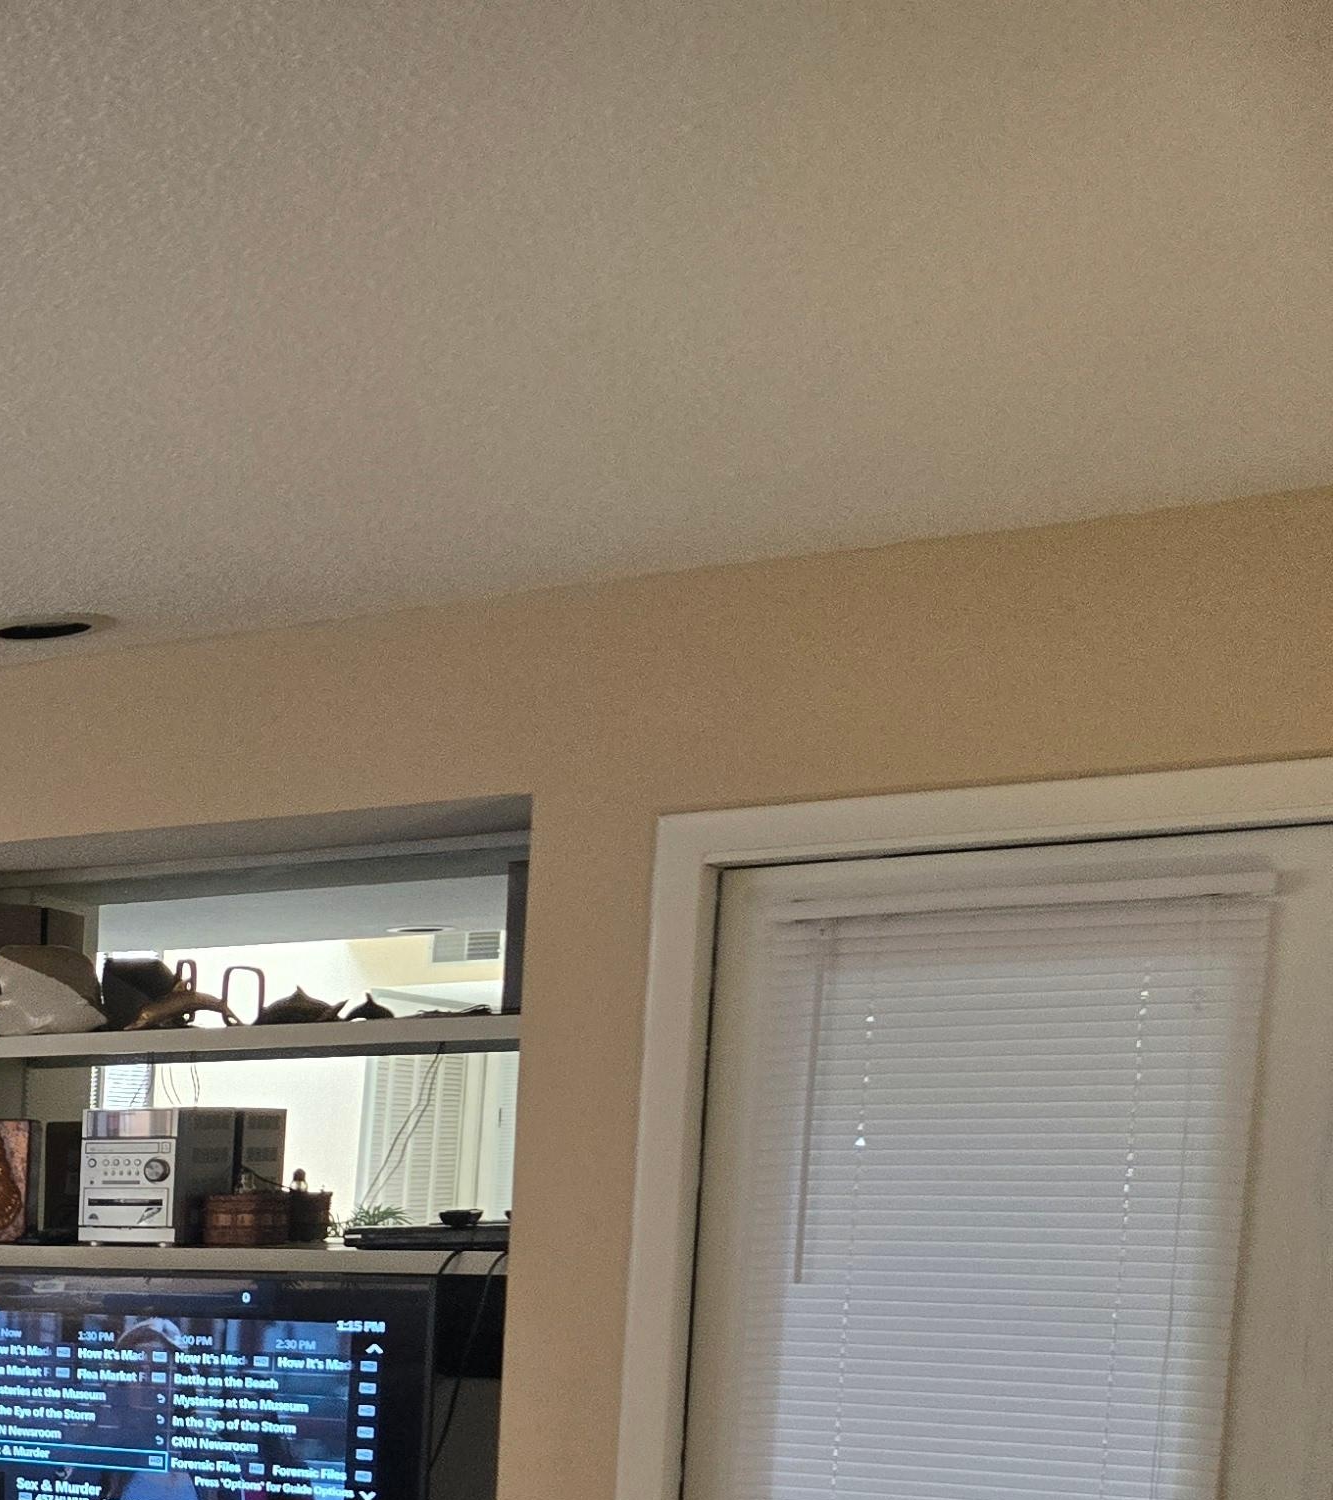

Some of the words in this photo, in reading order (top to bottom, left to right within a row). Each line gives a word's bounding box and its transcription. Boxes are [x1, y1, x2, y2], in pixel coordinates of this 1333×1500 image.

[1, 1328, 22, 1338] Now
[364, 1321, 385, 1333] PM
[78, 1331, 97, 1341] 1:30
[99, 1332, 114, 1342] PM
[196, 1336, 213, 1346] PM
[10, 1344, 26, 1356] It's
[275, 1339, 297, 1349] 2:30
[299, 1340, 316, 1350] PM
[78, 1348, 103, 1359] How
[103, 1349, 120, 1360] It's
[174, 1352, 201, 1364] How
[202, 1353, 219, 1365] It's
[277, 1356, 305, 1368] How
[306, 1358, 324, 1370] It's
[6, 1365, 42, 1377] Market
[99, 1369, 137, 1382] Market
[174, 1373, 206, 1386] Battle
[207, 1377, 223, 1386] on
[224, 1376, 243, 1388] the
[244, 1377, 278, 1390] Beach
[32, 1387, 43, 1397] at
[44, 1387, 61, 1398] the
[62, 1388, 106, 1400] Museum
[173, 1394, 224, 1409] Mysteries
[225, 1398, 238, 1409] at
[239, 1397, 258, 1410] the
[259, 1399, 309, 1413] Museum
[13, 1406, 31, 1418] Eye
[33, 1407, 44, 1417] of
[46, 1408, 62, 1419] the
[64, 1409, 95, 1421] Storm
[172, 1415, 184, 1427] In
[185, 1416, 204, 1428] the
[205, 1418, 225, 1431] Eye
[226, 1419, 239, 1430] of
[241, 1420, 260, 1432] the
[261, 1421, 297, 1434] Storm
[8, 1425, 62, 1439] Newsroom
[171, 1436, 198, 1449] CNN
[199, 1438, 258, 1453] Newsroom
[13, 1446, 50, 1459] Murder
[171, 1457, 214, 1471] Forensic
[216, 1460, 241, 1473] Files
[272, 1465, 319, 1479] Forensic
[321, 1469, 347, 1481] Files
[16, 1477, 39, 1491] Sex
[41, 1479, 53, 1492] &
[55, 1480, 102, 1496] Murder
[266, 1482, 281, 1493] for
[282, 1483, 312, 1495] Guide
[314, 1486, 355, 1499] Options
